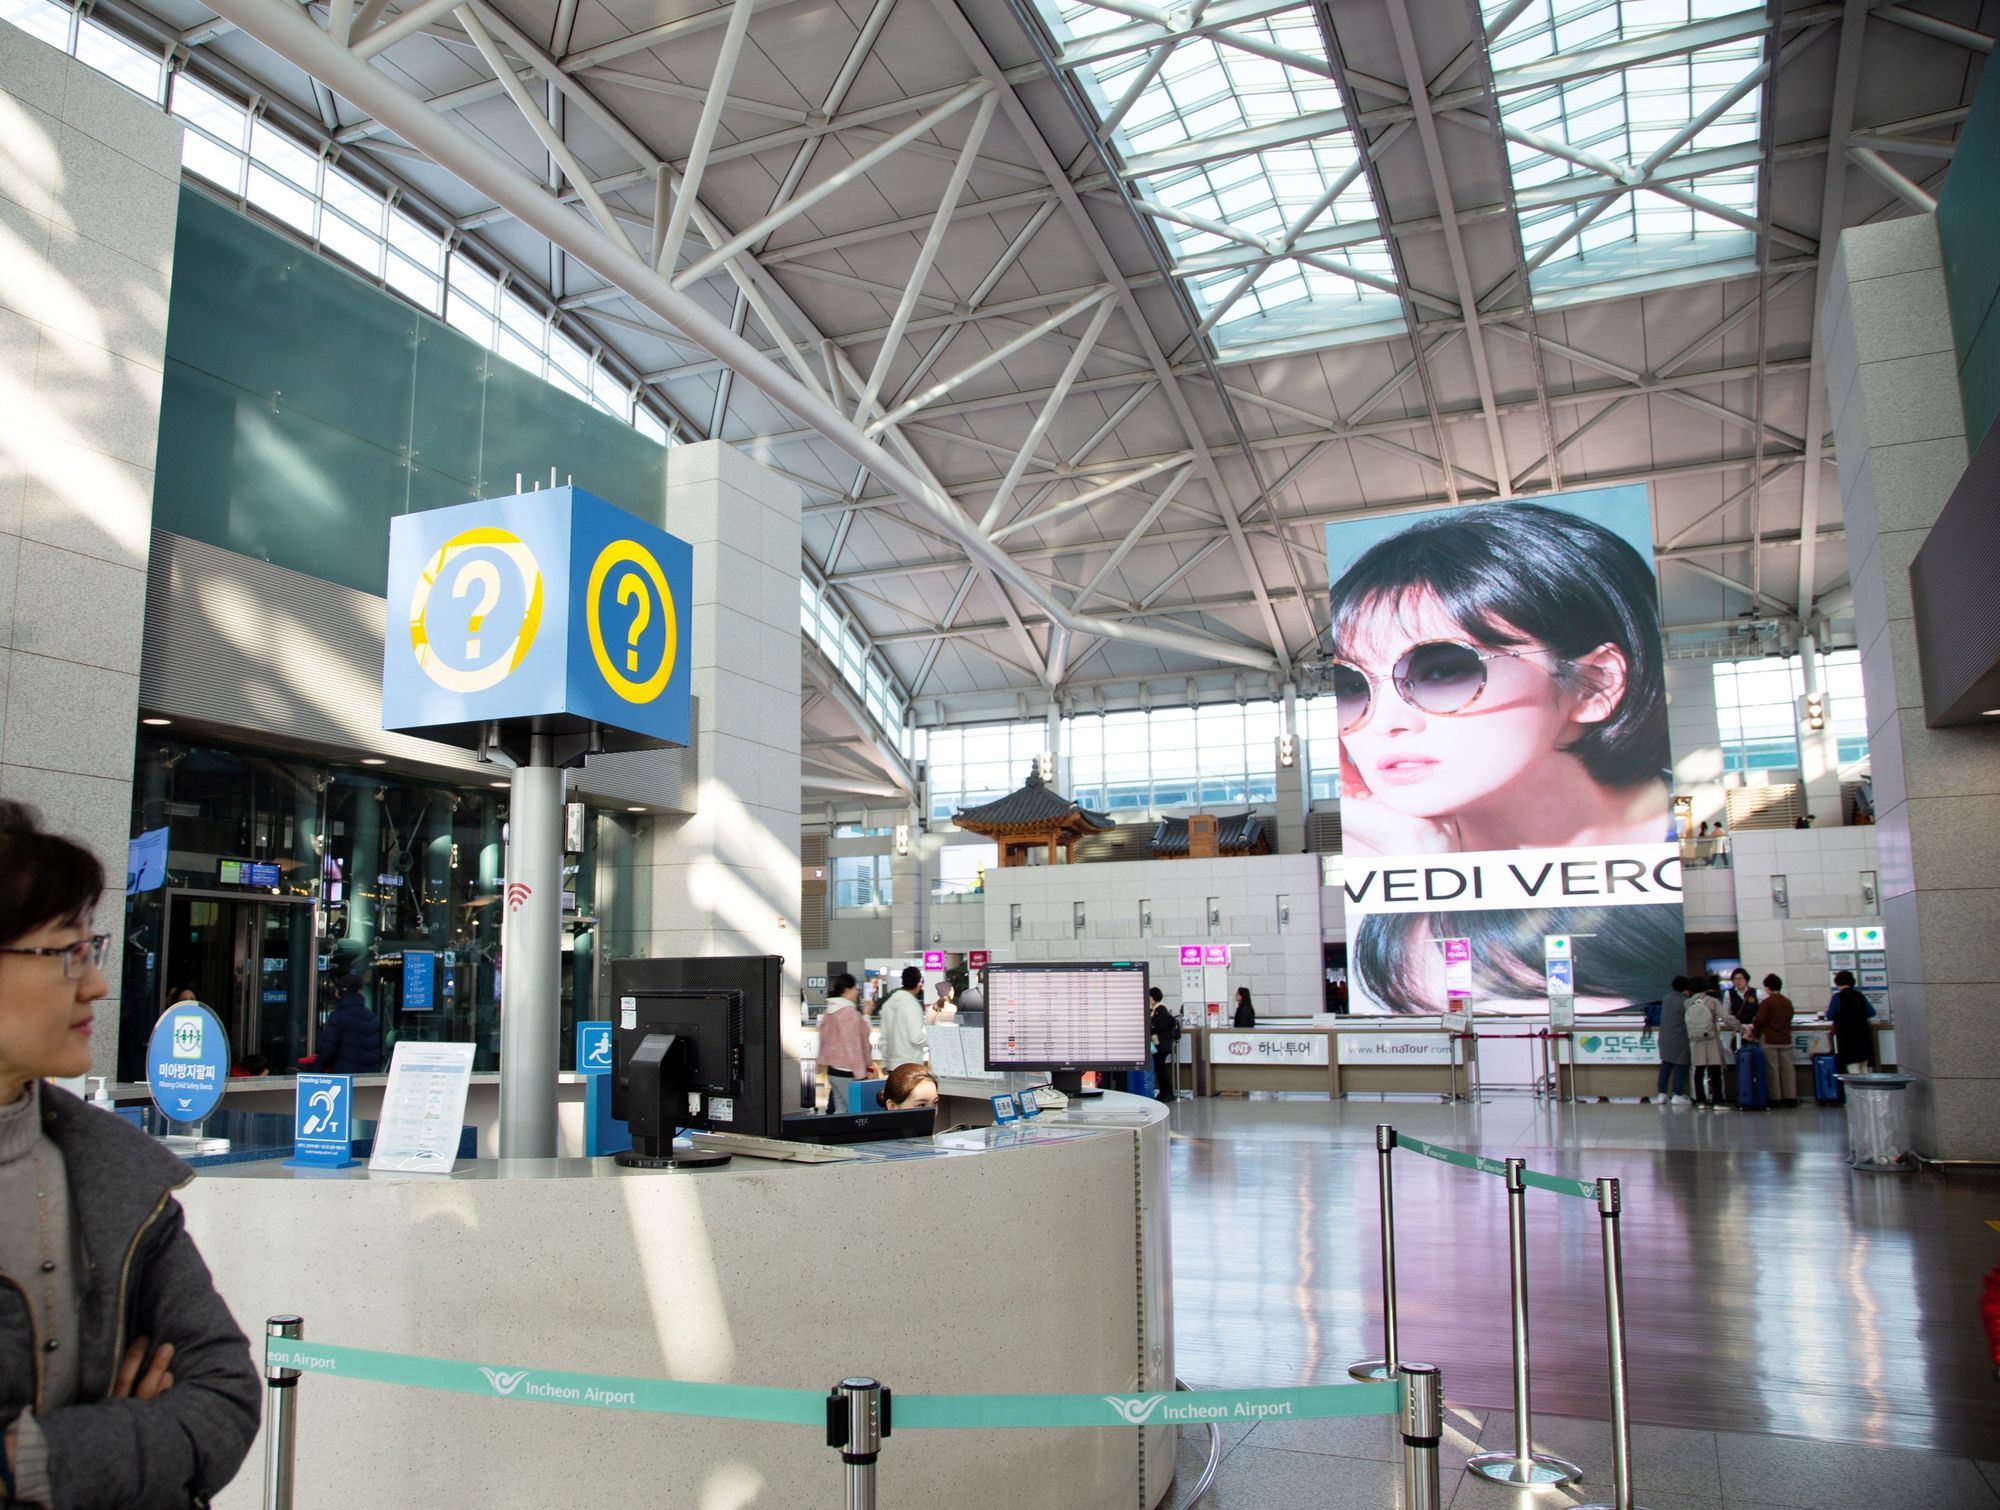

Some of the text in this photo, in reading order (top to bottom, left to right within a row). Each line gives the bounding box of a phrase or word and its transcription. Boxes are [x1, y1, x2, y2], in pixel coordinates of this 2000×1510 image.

[1345, 866, 1482, 903] VEDI
[1258, 1041, 1311, 1056] 하나투어
[159, 1063, 215, 1080] 미아방지팔찌
[292, 1352, 336, 1369] Airport
[526, 1381, 635, 1404] Incheon Airport
[1163, 1401, 1292, 1419] Incheon Airport
